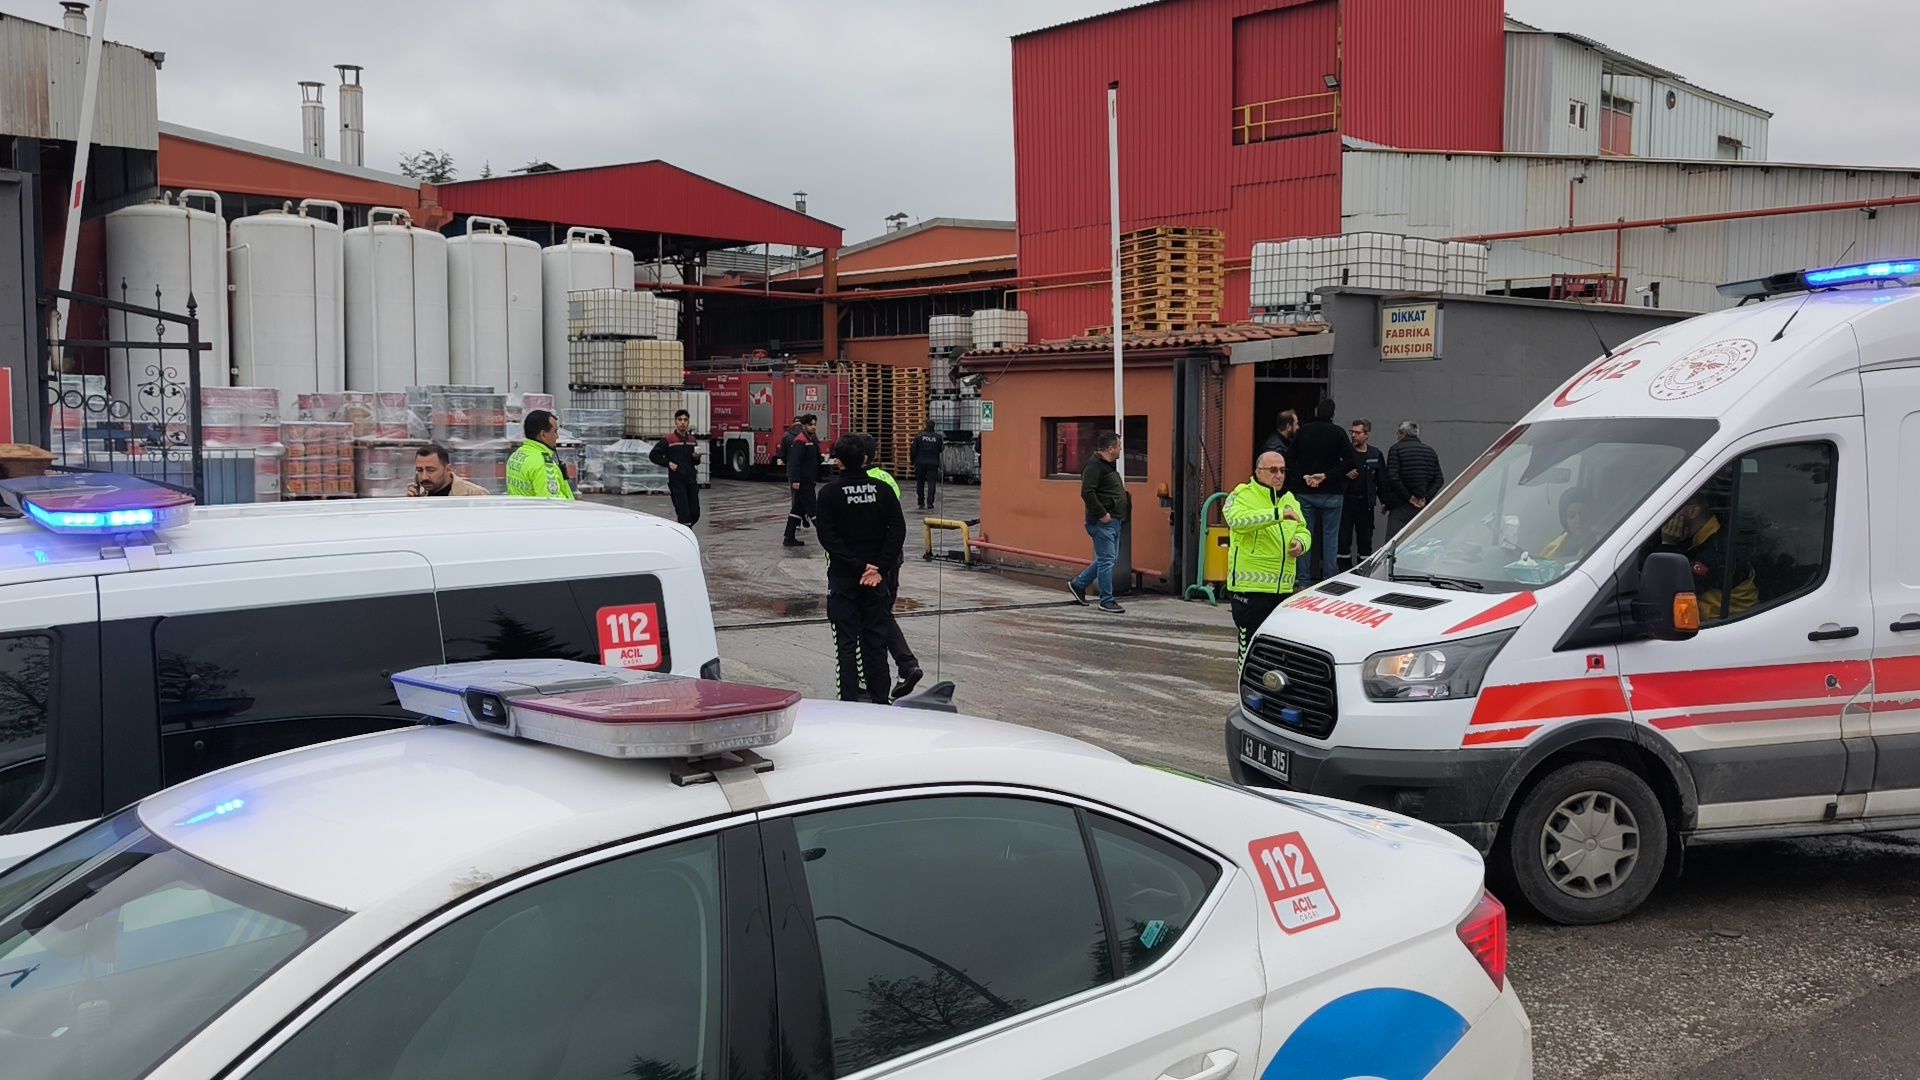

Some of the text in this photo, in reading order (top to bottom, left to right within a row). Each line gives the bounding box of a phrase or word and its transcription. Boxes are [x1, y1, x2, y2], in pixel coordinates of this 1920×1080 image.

[1391, 309, 1427, 323] DİKKAT
[1382, 343, 1433, 356] ÇIKIŞIDIR
[606, 611, 651, 644] 112
[1258, 743, 1267, 764] AC
[1271, 749, 1286, 771] 615
[1261, 843, 1315, 892] 112
